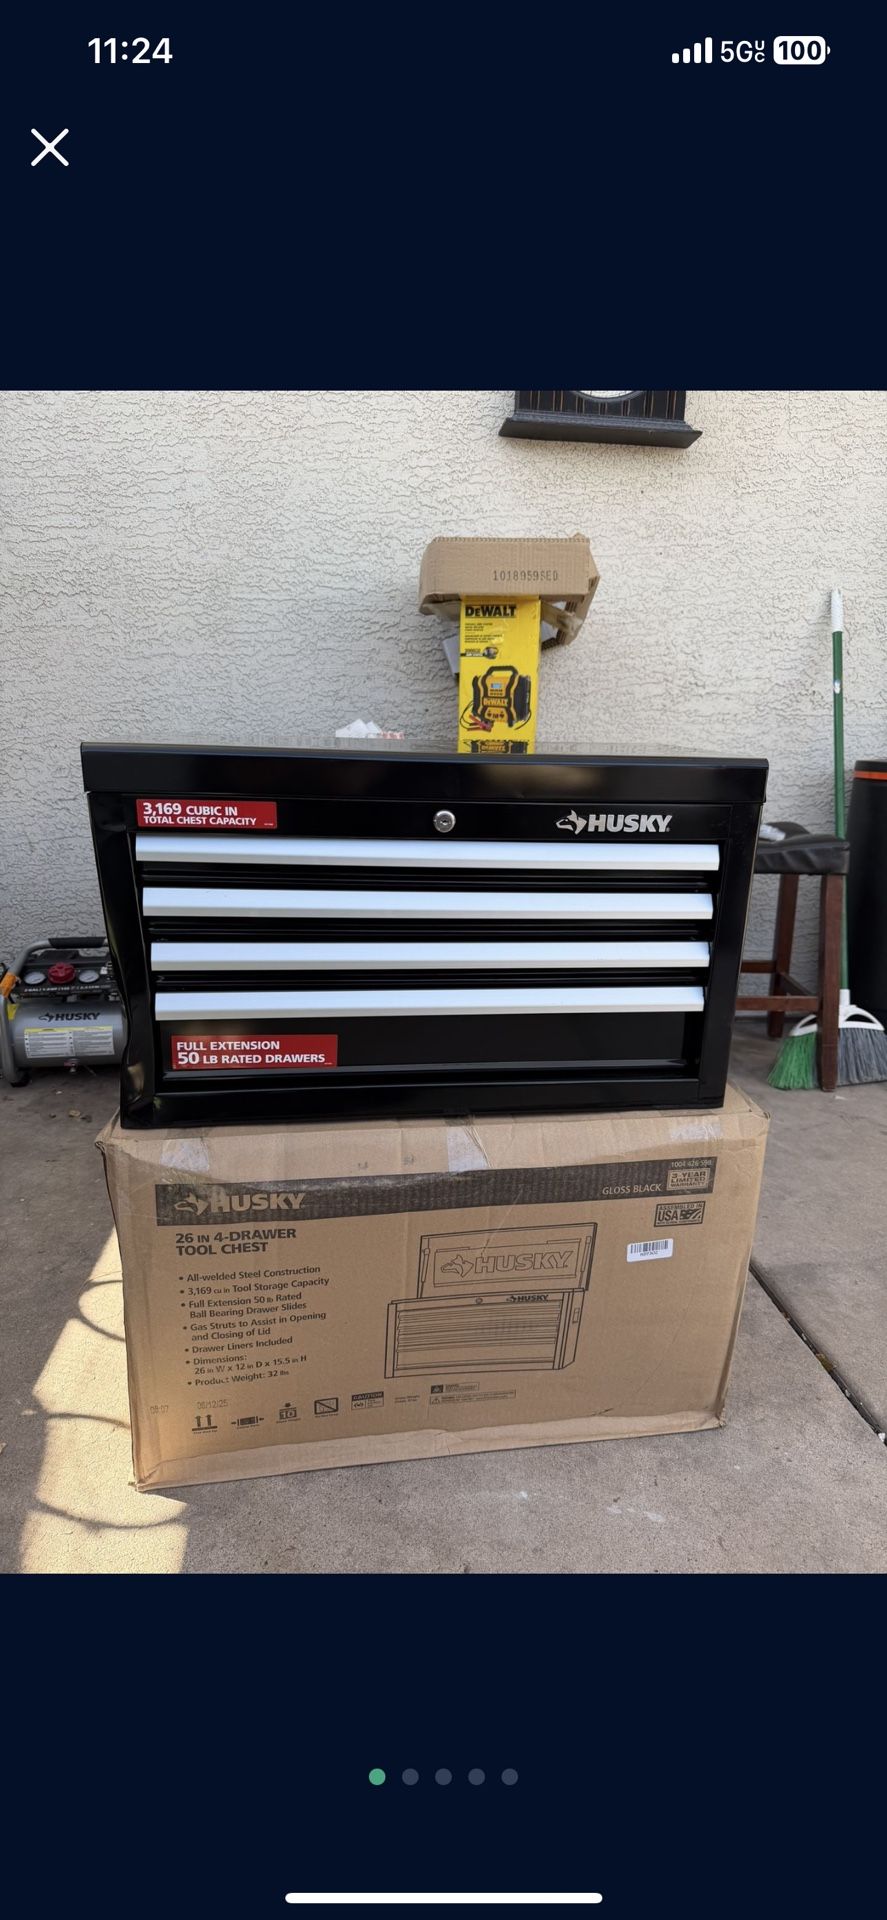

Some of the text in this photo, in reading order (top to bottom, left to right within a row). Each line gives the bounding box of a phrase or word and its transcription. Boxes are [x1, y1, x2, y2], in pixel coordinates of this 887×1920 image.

[143, 802, 238, 816] 3,169 CUBIC IN
[143, 816, 256, 826] TOTAL CHEST CAPACITY
[587, 814, 672, 832] HUSKY
[55, 1012, 101, 1021] HUSKY
[176, 1041, 280, 1051] FULL EXTENSION
[178, 1052, 325, 1065] 50 LB RATED DRAWERS
[602, 1183, 662, 1195] GLOSS BLACK
[211, 1192, 305, 1213] HUSKY
[657, 1210, 679, 1222] USA
[176, 1228, 297, 1244] 26 IN 4-DRAWER
[176, 1242, 268, 1256] TOOL CHEST
[474, 1250, 574, 1274] HUSKY
[187, 1265, 321, 1282] All-welded Steel Construction
[187, 1286, 212, 1296] 3,169
[232, 1284, 251, 1293] Tool
[254, 1280, 289, 1291] Storage
[291, 1277, 330, 1289] Capacity
[189, 1300, 205, 1309] Full
[207, 1297, 251, 1308] Extension
[254, 1296, 265, 1304] 50
[276, 1292, 302, 1302] Rated
[517, 1294, 549, 1303] HUSKY
[190, 1302, 307, 1319] Ball Bearing Drawer Slides
[190, 1323, 208, 1332] Gas
[210, 1321, 236, 1330] Struts
[251, 1317, 276, 1326] Assist
[279, 1315, 287, 1323] in
[290, 1312, 327, 1323] Opening
[191, 1327, 271, 1341] and Closing of Lid
[192, 1336, 293, 1354] Drawer Liners Included
[193, 1354, 248, 1366] Dimensions:
[194, 1366, 206, 1375] 26
[215, 1364, 226, 1373] W
[236, 1362, 245, 1371] 12
[273, 1356, 291, 1366] 15.5
[231, 1372, 266, 1383] Weight:
[267, 1370, 278, 1378] 32
